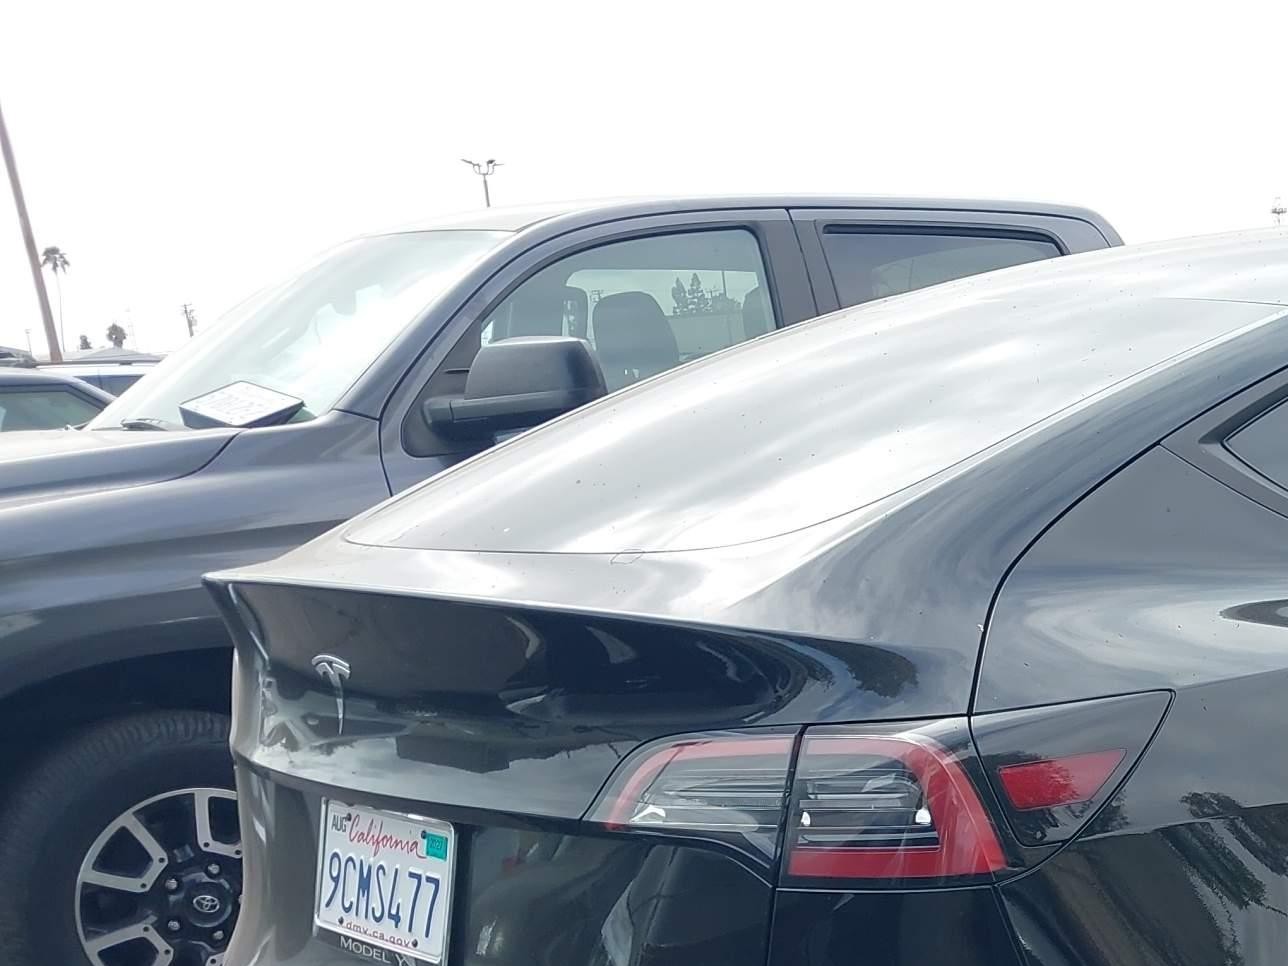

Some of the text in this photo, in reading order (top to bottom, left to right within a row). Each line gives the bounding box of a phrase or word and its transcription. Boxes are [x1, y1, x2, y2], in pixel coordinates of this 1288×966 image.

[331, 814, 347, 833] AUG
[349, 814, 427, 858] California
[325, 851, 440, 939] 9CMS477
[346, 921, 411, 948] dmv.ca.gov
[340, 935, 392, 964] MODEL
